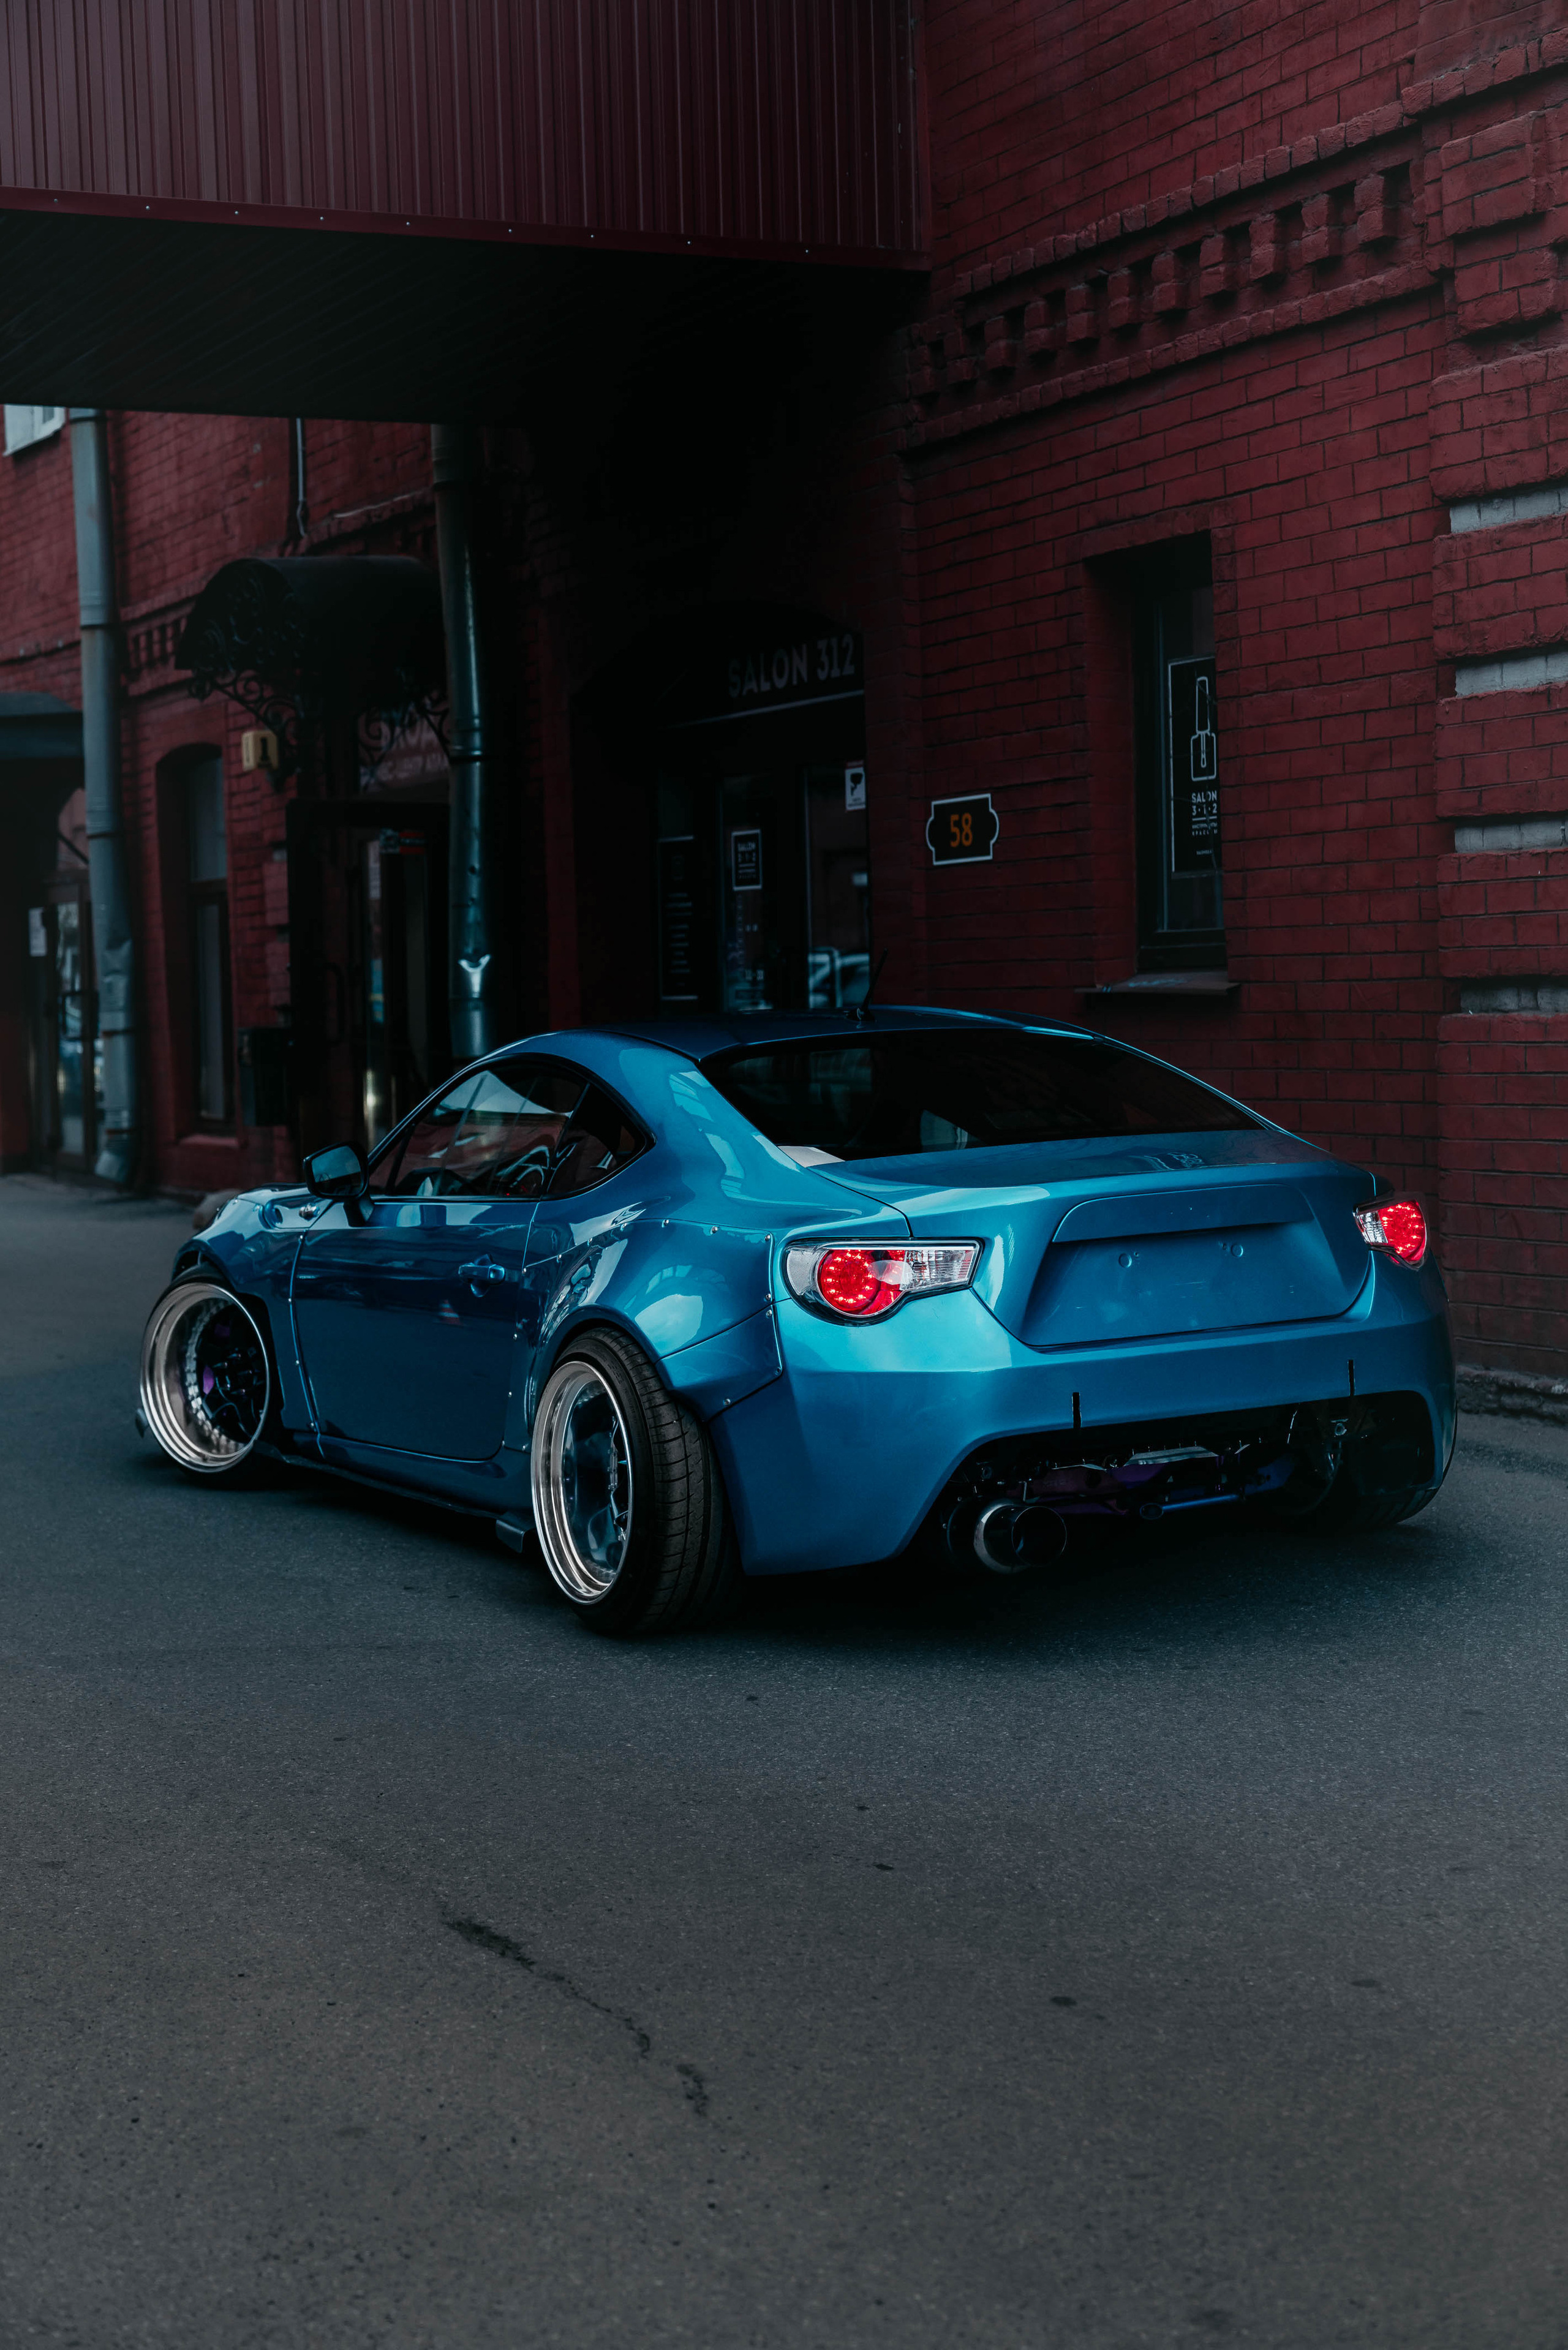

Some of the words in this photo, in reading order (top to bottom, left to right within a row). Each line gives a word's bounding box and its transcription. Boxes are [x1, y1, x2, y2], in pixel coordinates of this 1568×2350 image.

[728, 644, 809, 698] SALON
[816, 633, 856, 681] 312
[1191, 790, 1218, 803] SALON
[950, 812, 973, 848] 58
